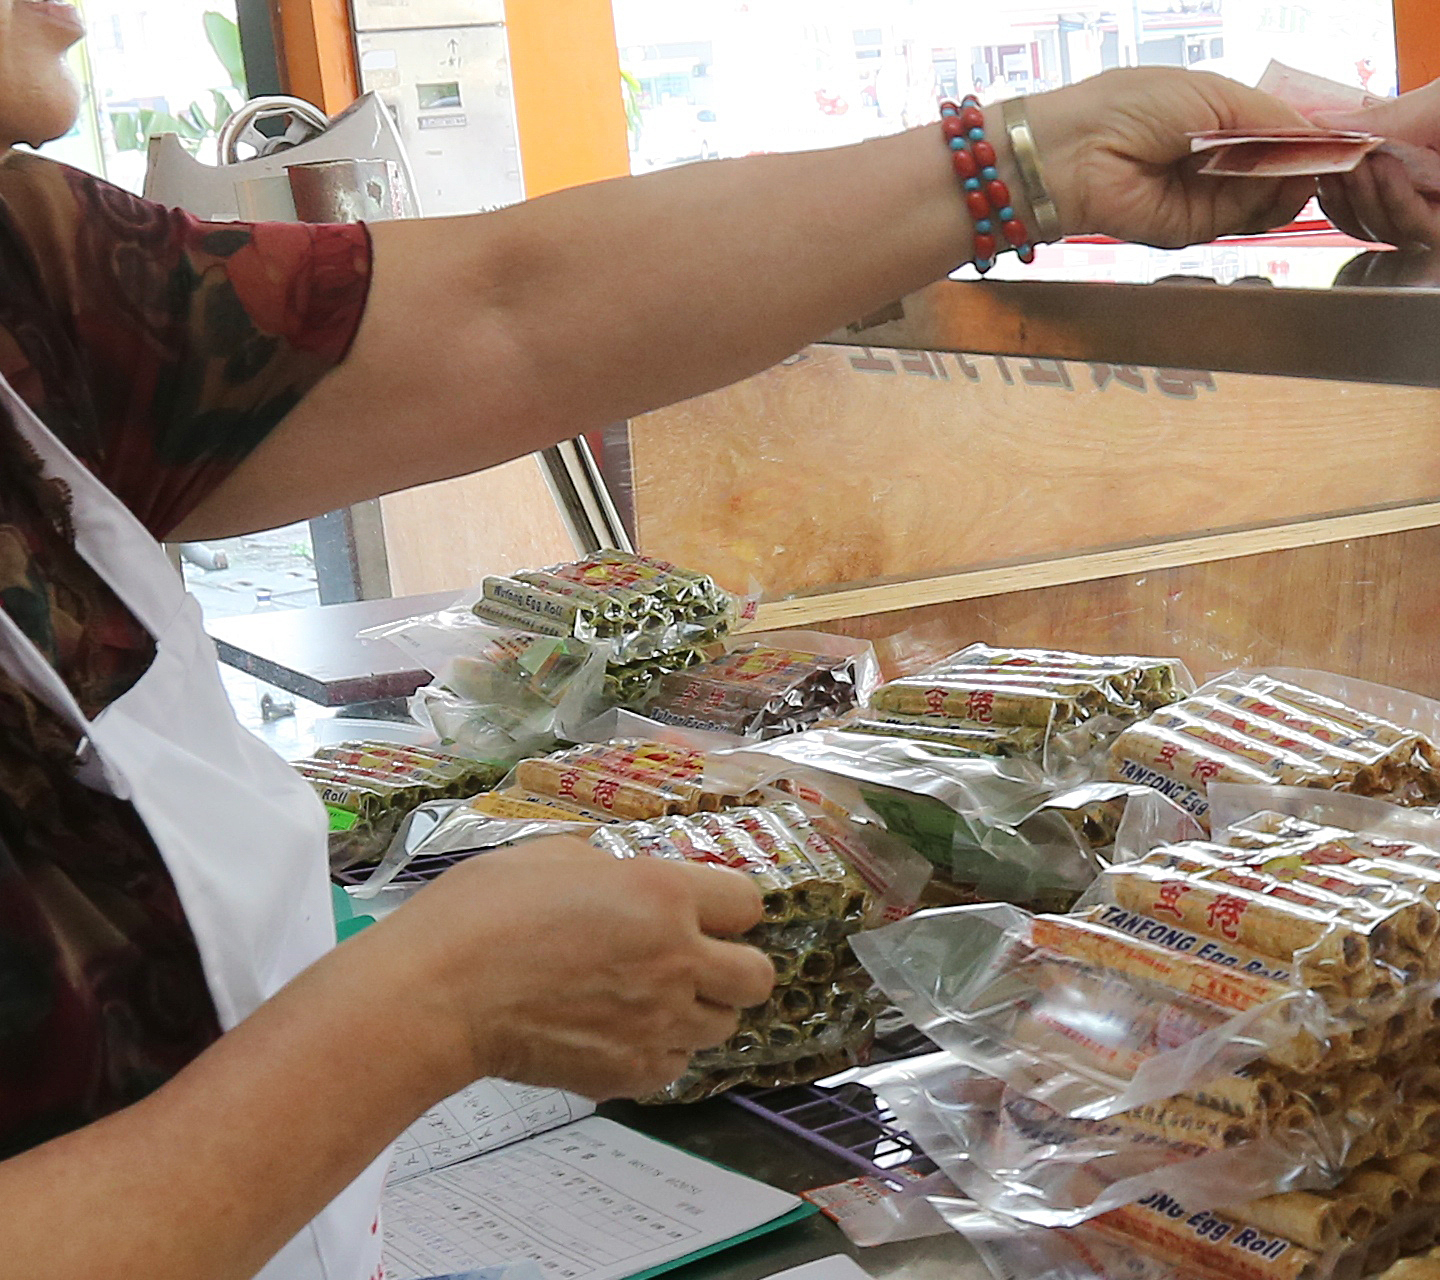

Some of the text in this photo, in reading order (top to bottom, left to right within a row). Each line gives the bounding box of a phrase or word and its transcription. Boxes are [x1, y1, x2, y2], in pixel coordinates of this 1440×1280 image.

[321, 786, 349, 804] Roll
[1181, 790, 1210, 818] Egg
[1100, 906, 1197, 952] TANFONG
[1186, 1210, 1233, 1244] Egg
[1233, 1227, 1288, 1261] Roll
